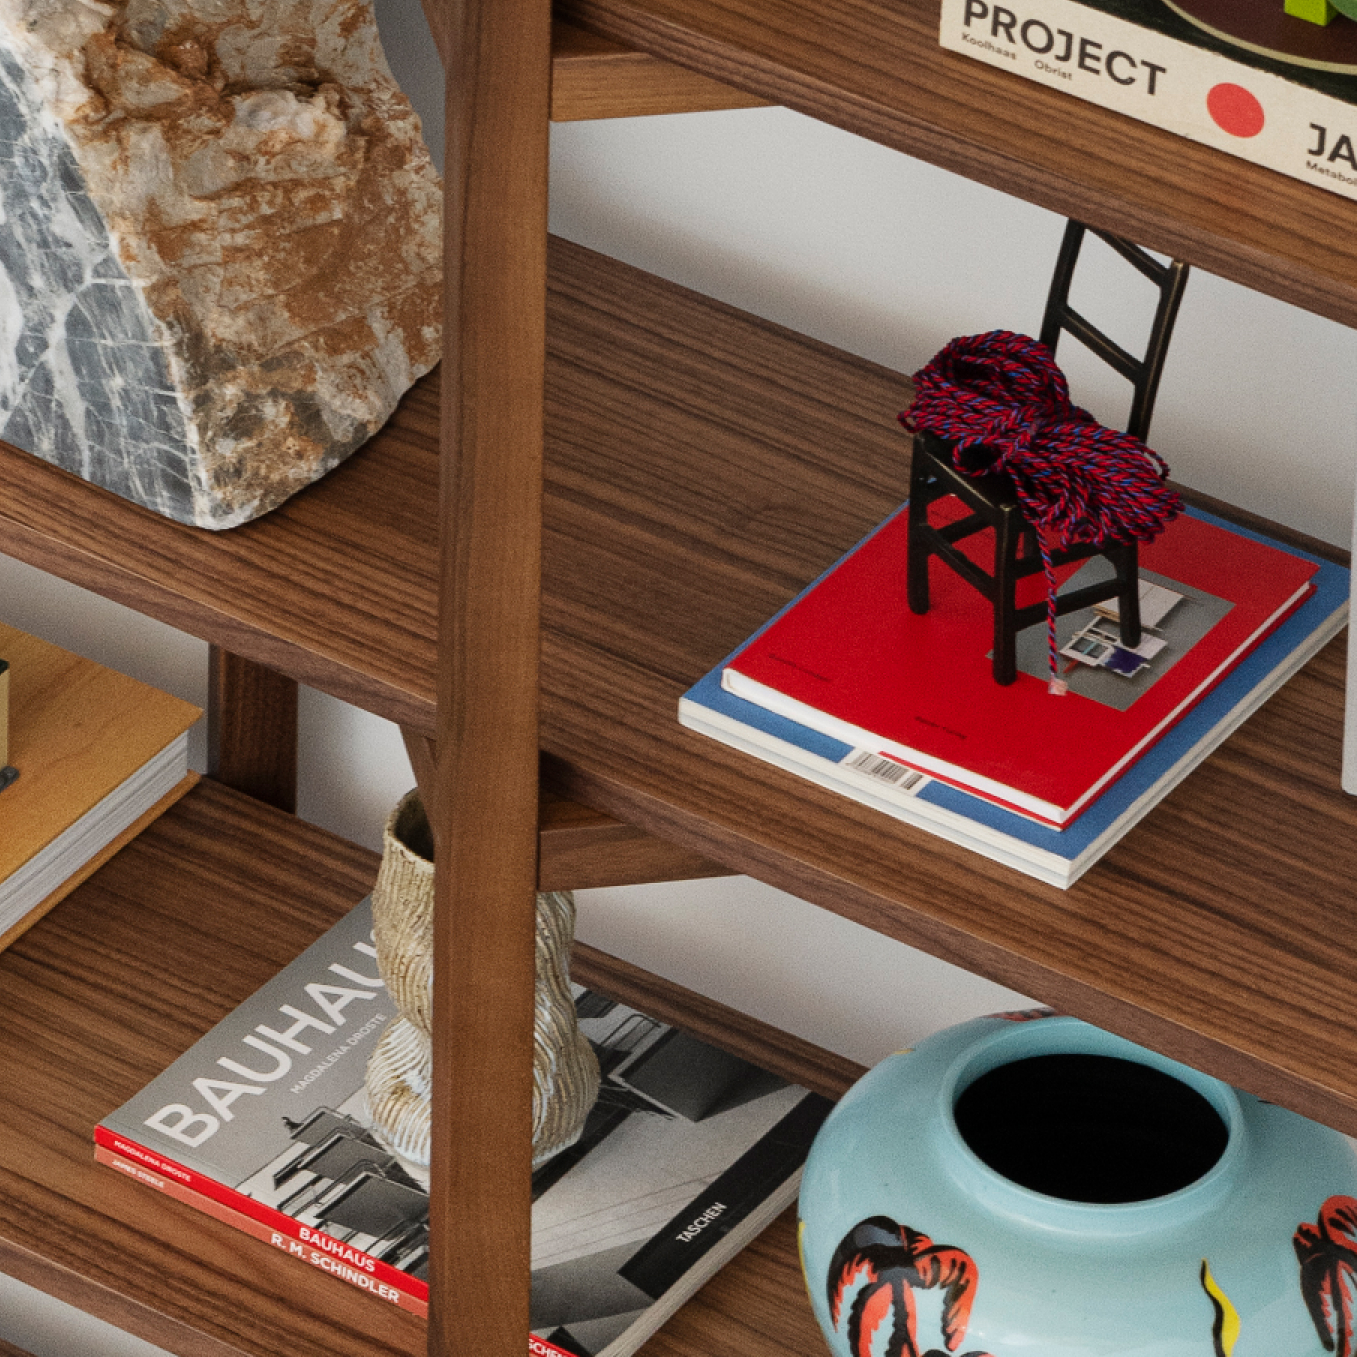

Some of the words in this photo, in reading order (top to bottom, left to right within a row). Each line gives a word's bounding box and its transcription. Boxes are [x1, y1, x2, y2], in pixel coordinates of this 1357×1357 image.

[961, 32, 1018, 60] Koolhaas
[1034, 59, 1073, 81] Obrist
[143, 929, 386, 1148] BAUHAU
[289, 1039, 350, 1095] MAGDALENA
[349, 1013, 388, 1047] DROSTE
[111, 1158, 137, 1178] JAMES
[136, 1168, 166, 1189] STEELE
[271, 1233, 287, 1251] R.
[288, 1241, 307, 1260] M.
[309, 1251, 400, 1305] SCHINDLER
[114, 1140, 160, 1169] MAGDALENA
[160, 1160, 192, 1183] DROSTE
[298, 1227, 377, 1273] BAUHAUS
[675, 1201, 728, 1242] TASCHEN
